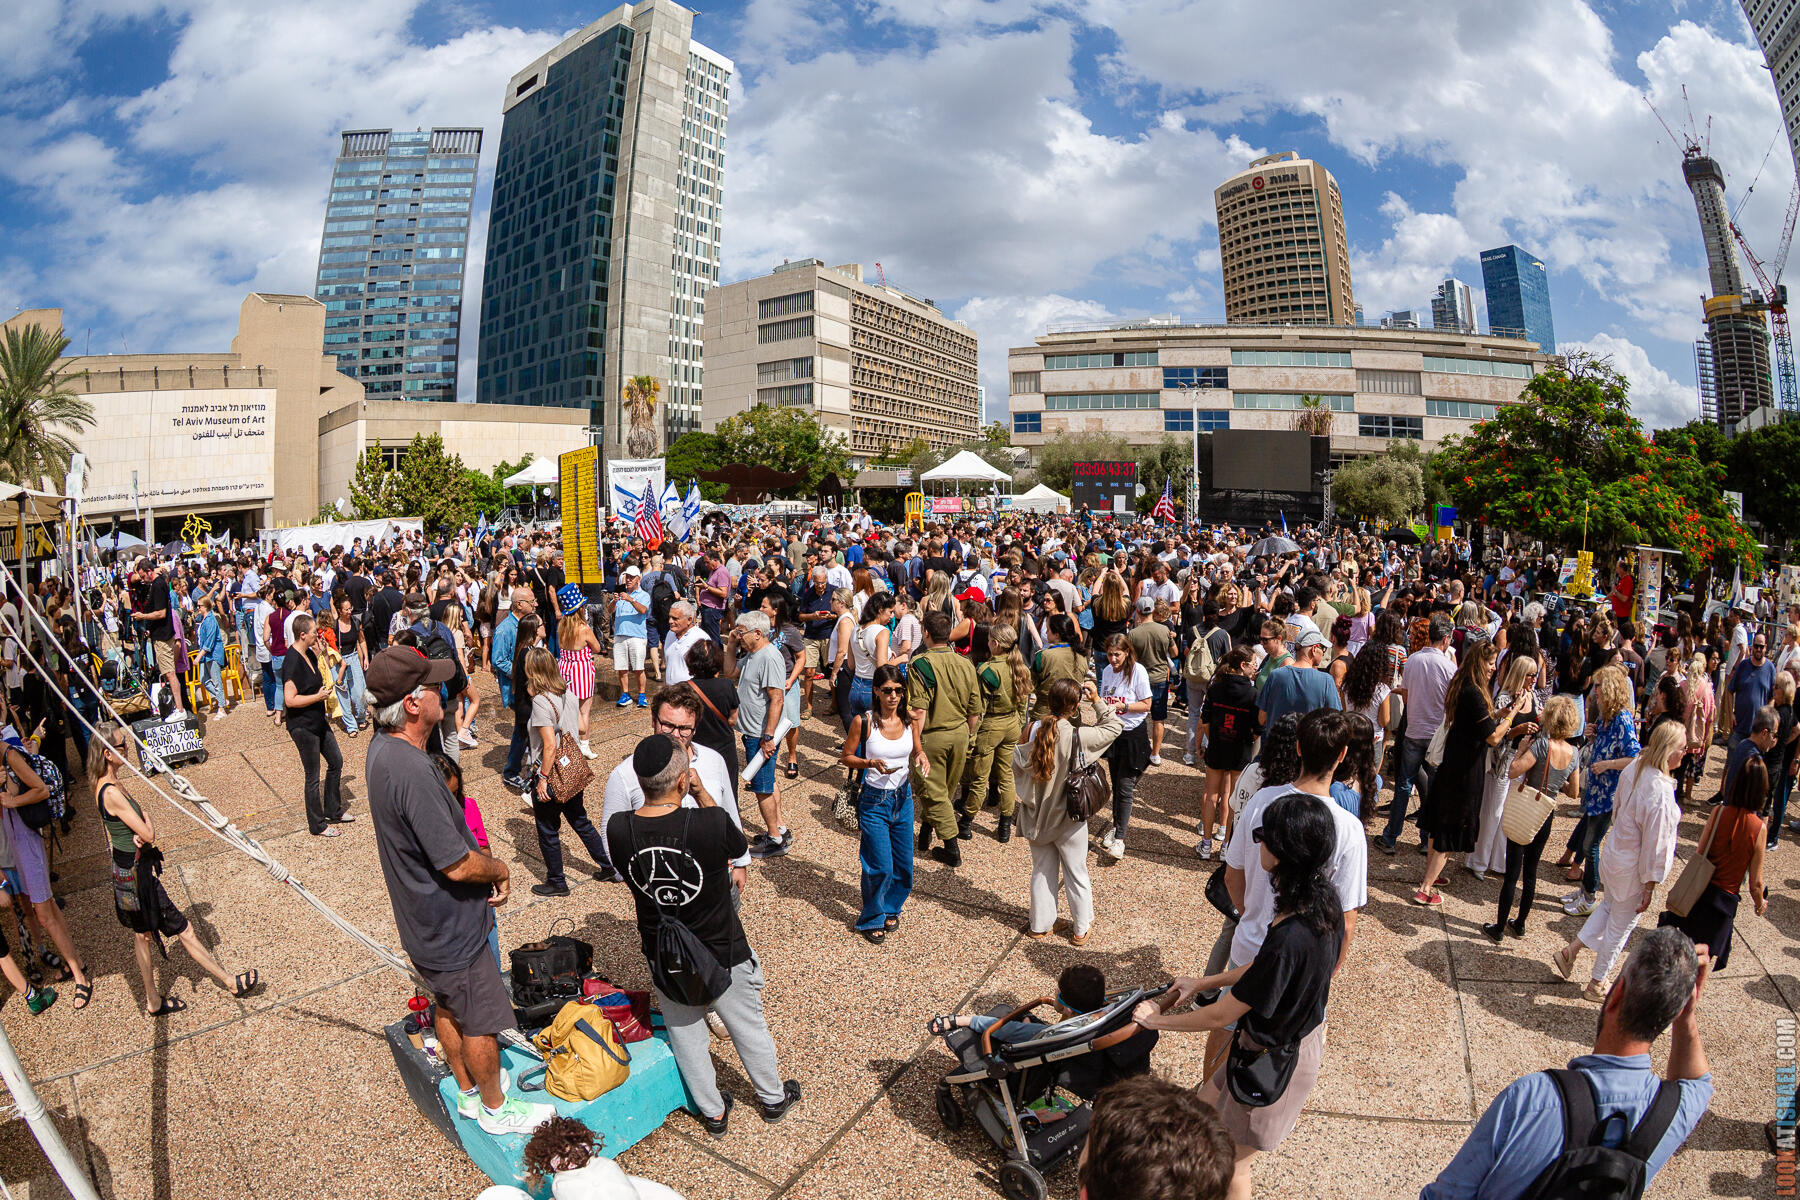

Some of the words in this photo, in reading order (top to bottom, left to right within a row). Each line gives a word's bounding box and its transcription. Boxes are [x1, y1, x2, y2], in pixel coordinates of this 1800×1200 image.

[181, 404, 209, 413] לאמנות
[210, 404, 228, 412] אביב
[228, 403, 239, 412] תל
[241, 404, 266, 412] מוזיאון
[172, 417, 184, 427] Tel
[186, 417, 203, 426] Aviv
[204, 416, 240, 425] Museum
[241, 415, 250, 424] of
[252, 416, 265, 424] Art
[192, 429, 215, 441] للفنون
[217, 427, 232, 440] أبيب
[234, 428, 243, 439] تل
[244, 428, 265, 437] متحف
[1073, 462, 1135, 476] 733:06:43:37
[108, 493, 129, 501] Building
[146, 728, 157, 739] 48
[159, 722, 185, 736] SOULS
[178, 730, 194, 742] 700
[163, 743, 180, 755] TOO
[182, 739, 203, 752] LONG
[1047, 1129, 1067, 1143] Oyster
